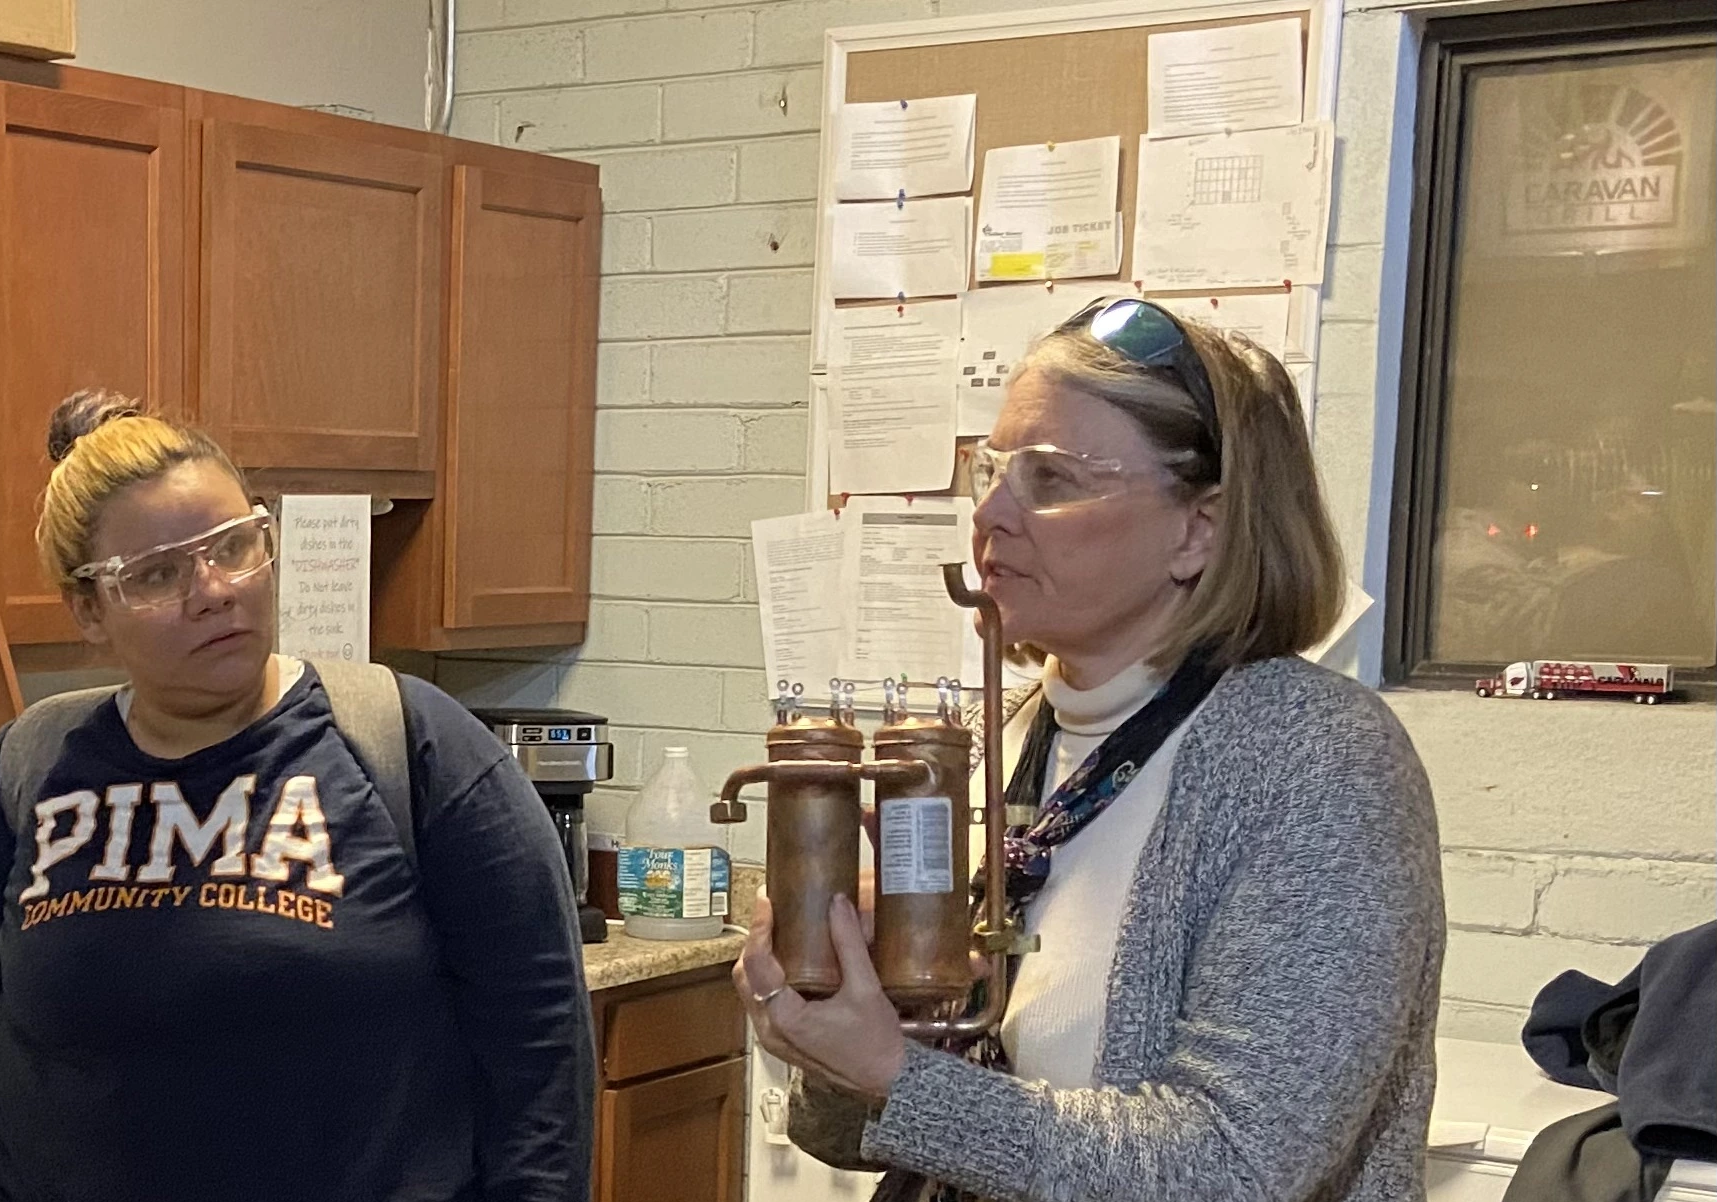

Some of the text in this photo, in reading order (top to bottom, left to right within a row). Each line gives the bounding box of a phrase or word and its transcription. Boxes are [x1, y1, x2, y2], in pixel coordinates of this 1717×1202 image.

[1048, 221, 1112, 235] JOB TICKET
[19, 773, 345, 904] PIMA
[20, 882, 334, 931] COMMUNITY COLLEGE
